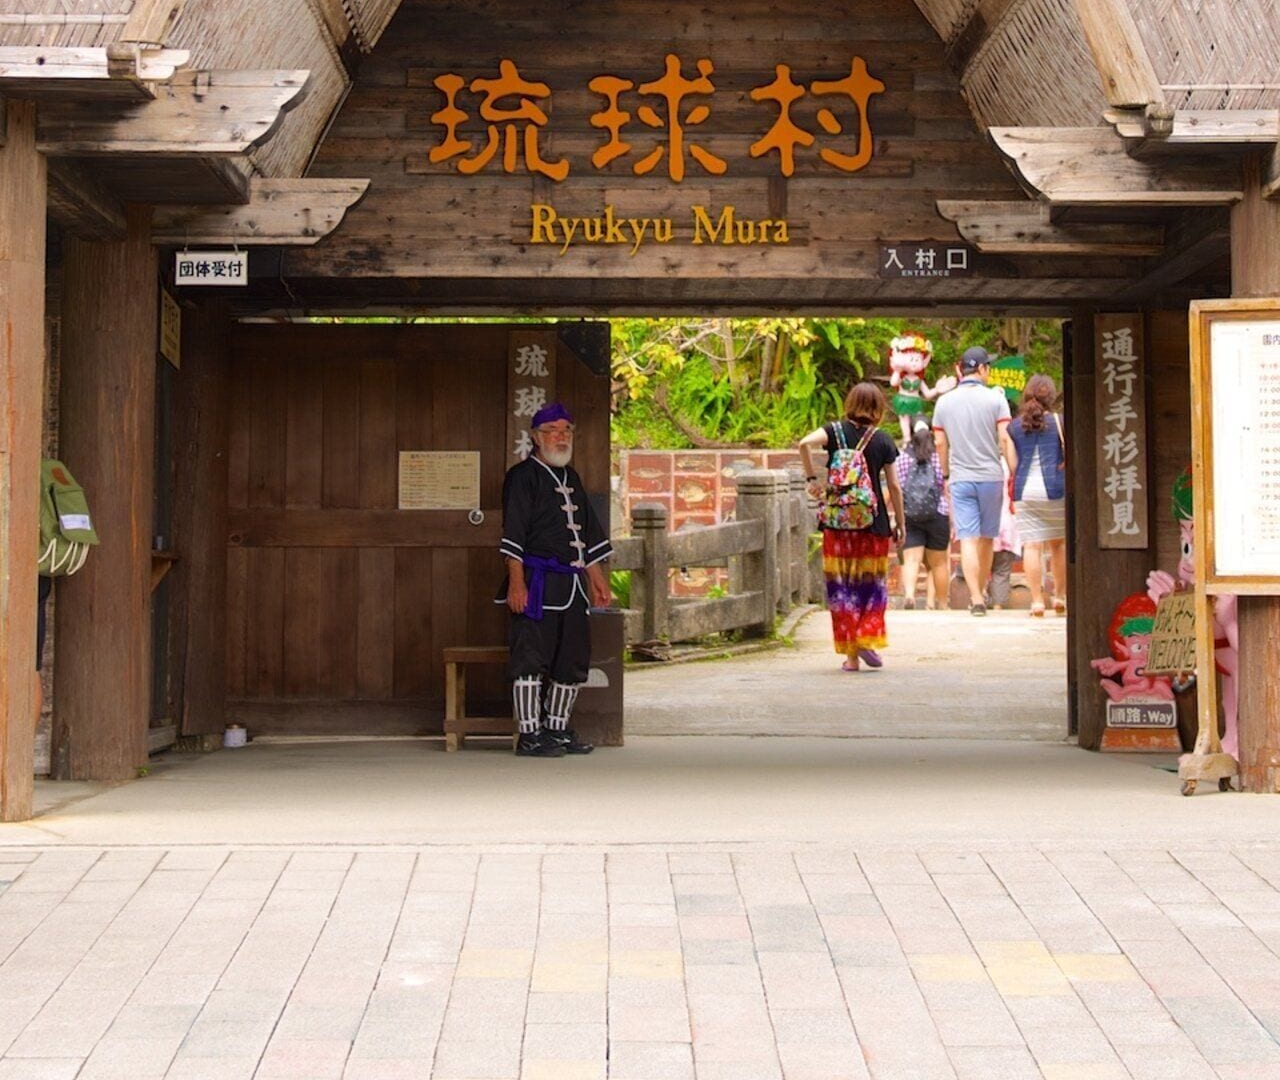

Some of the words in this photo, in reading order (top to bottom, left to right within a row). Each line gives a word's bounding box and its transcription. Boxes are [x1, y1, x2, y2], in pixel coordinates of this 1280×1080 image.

[429, 54, 886, 183] 琉球村
[530, 204, 673, 257] Ryukyu
[692, 205, 790, 246] Mura
[179, 260, 243, 277] 団体受付
[885, 248, 967, 269] 入村口
[1102, 327, 1142, 535] 通行手形拝見
